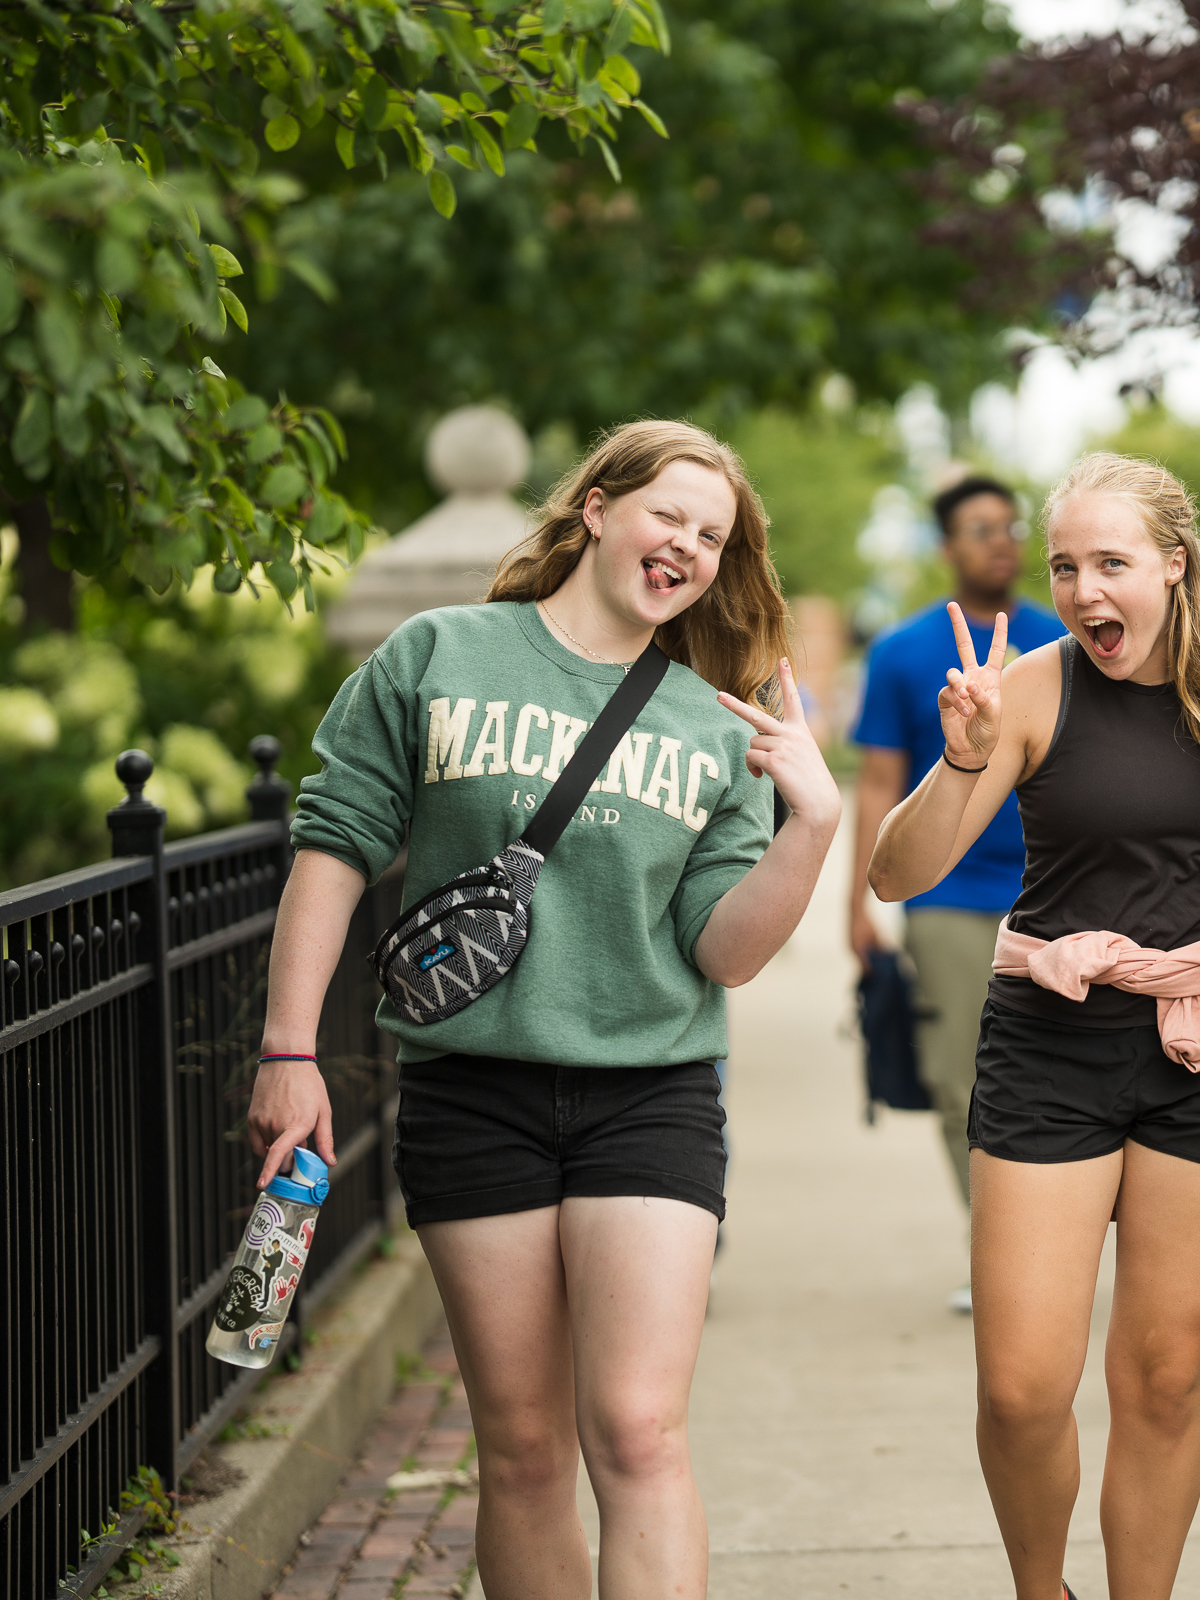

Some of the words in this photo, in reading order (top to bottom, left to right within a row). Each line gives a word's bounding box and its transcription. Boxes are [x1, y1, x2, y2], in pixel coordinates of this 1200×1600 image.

[424, 697, 719, 832] MACKNAC
[510, 790, 621, 824] ISND
[424, 948, 451, 967] KAVU
[252, 1214, 271, 1234] CORE
